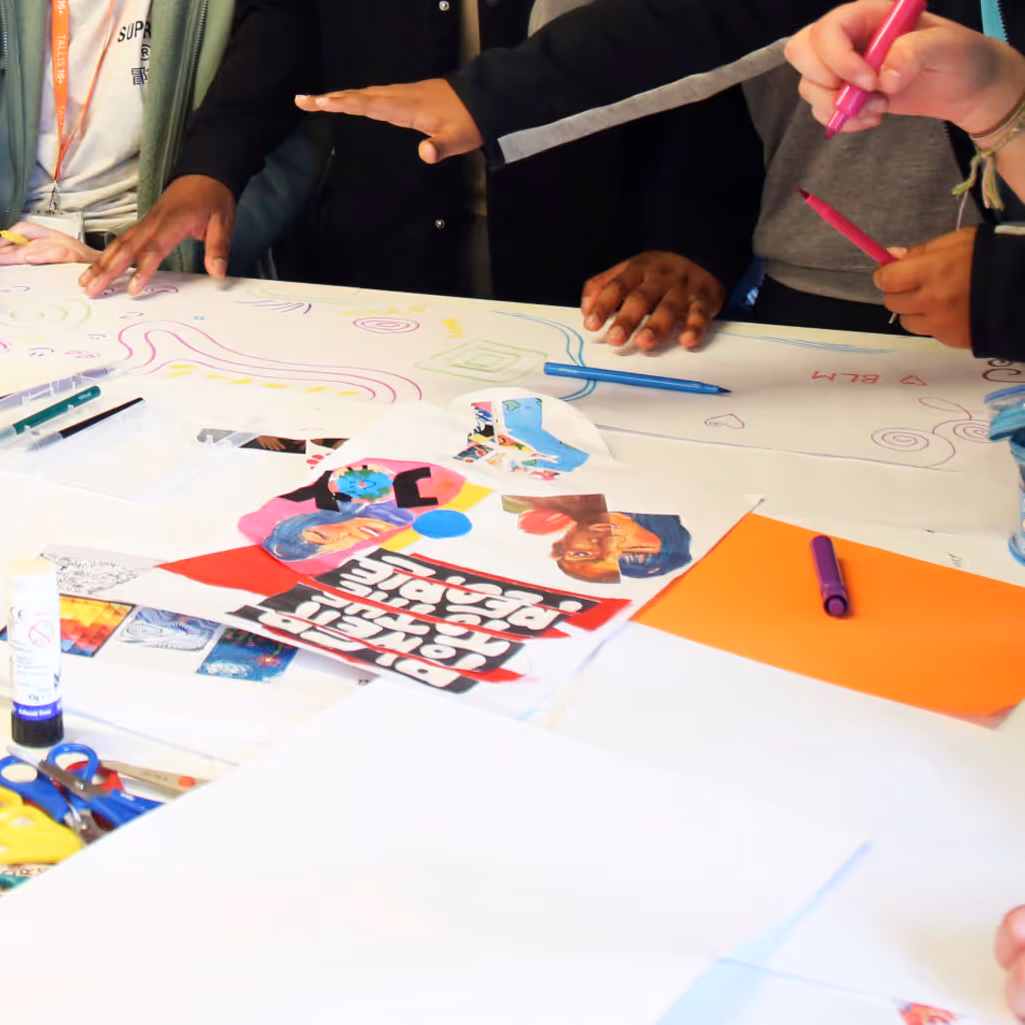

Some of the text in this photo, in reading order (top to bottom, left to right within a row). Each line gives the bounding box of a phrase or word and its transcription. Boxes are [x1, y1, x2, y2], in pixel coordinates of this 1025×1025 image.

[57, 0, 66, 15] 16+
[117, 20, 152, 43] SUPR
[57, 34, 66, 85] TALLIS 16+
[809, 370, 880, 385] BLM
